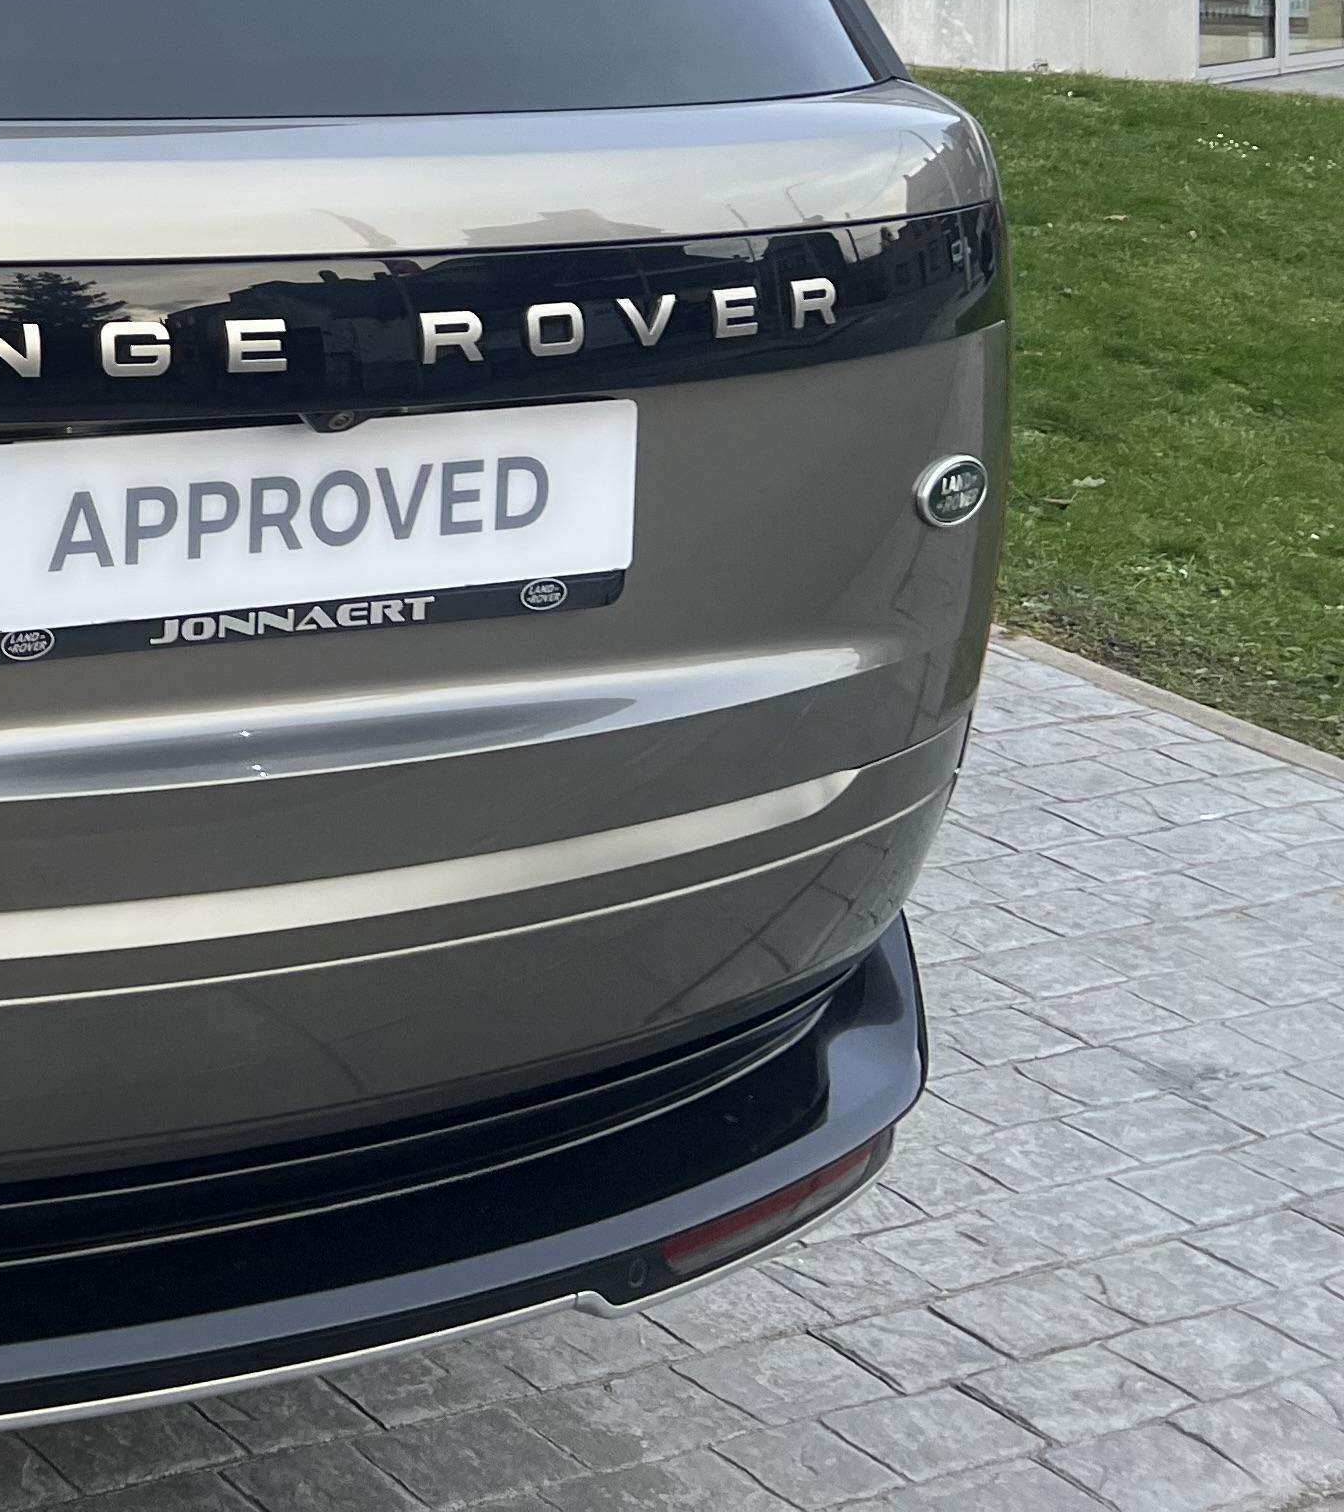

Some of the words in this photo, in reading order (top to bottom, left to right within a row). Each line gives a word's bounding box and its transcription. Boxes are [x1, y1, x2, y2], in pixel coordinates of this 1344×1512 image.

[420, 277, 837, 365] ROVER
[48, 455, 551, 572] APPROVED
[149, 595, 435, 645] JONNAERT
